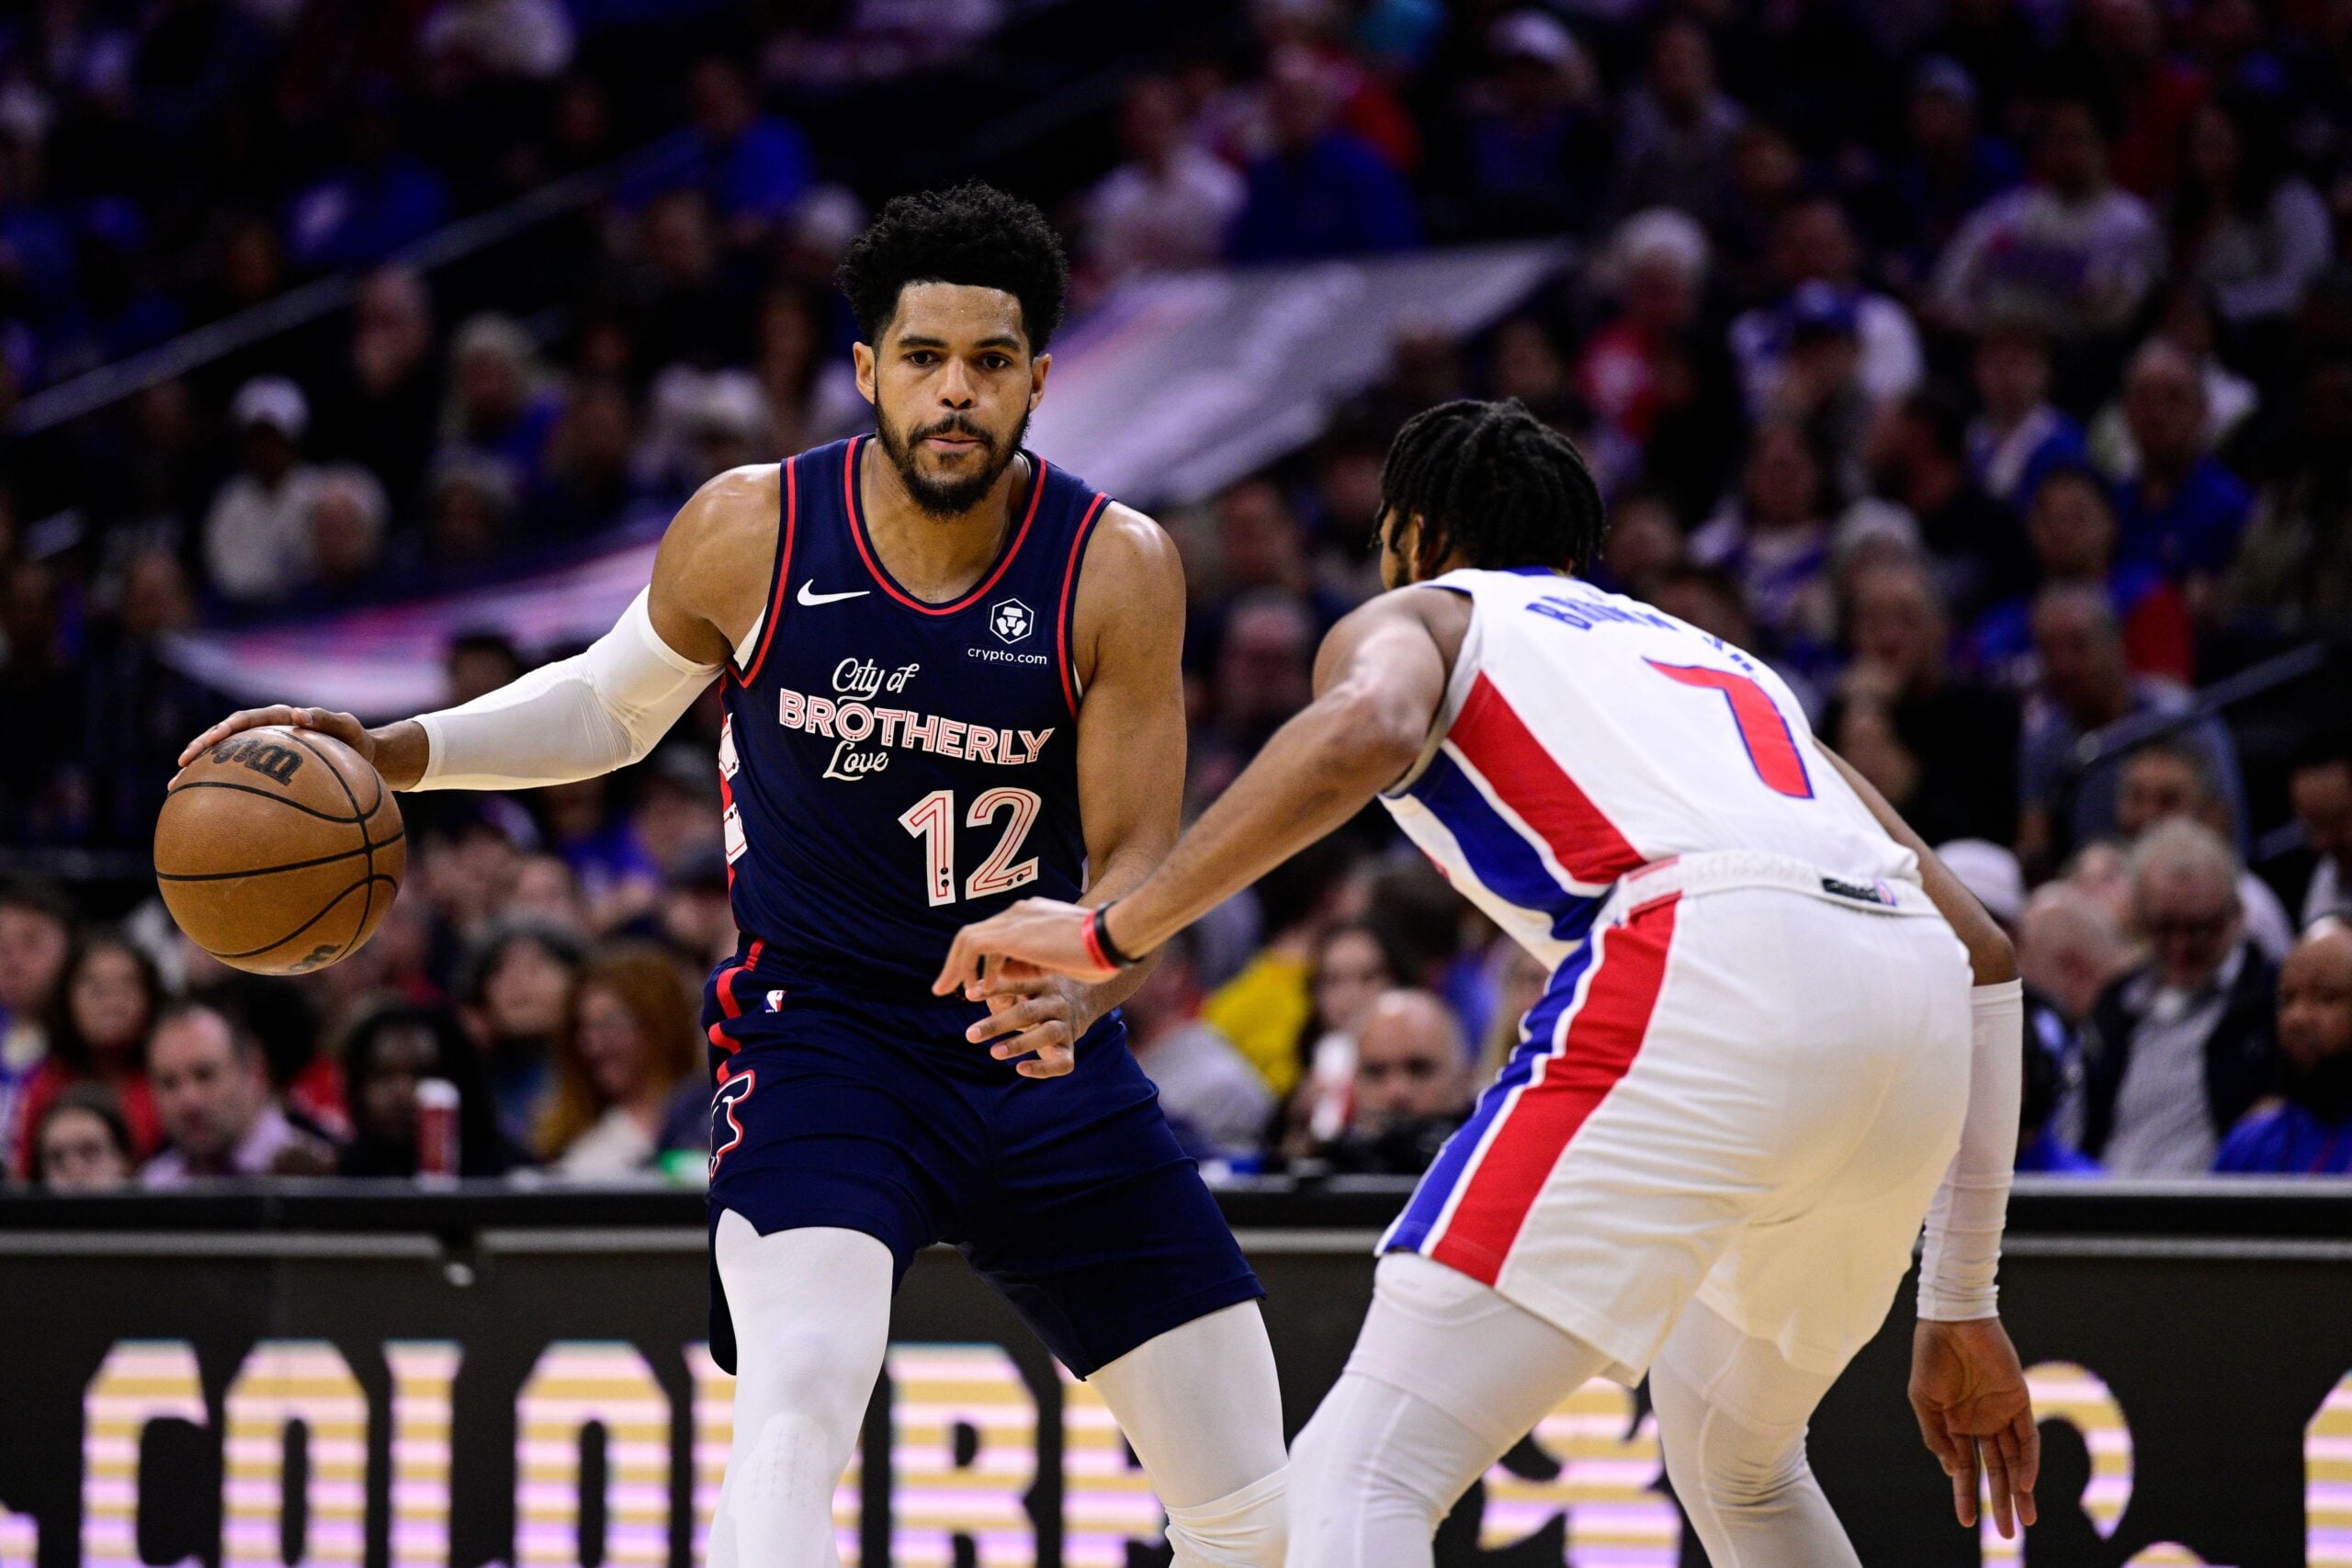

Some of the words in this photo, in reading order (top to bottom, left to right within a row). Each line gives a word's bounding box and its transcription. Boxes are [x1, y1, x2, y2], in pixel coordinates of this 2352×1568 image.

[831, 657, 885, 705] City
[887, 662, 920, 694] of
[967, 648, 1047, 665] crypto.com
[779, 687, 1056, 765] BROTHERLY
[822, 740, 889, 782] Love
[1641, 655, 1815, 800] 7
[898, 786, 1043, 908] 12
[81, 1338, 1169, 1568] COLOB
